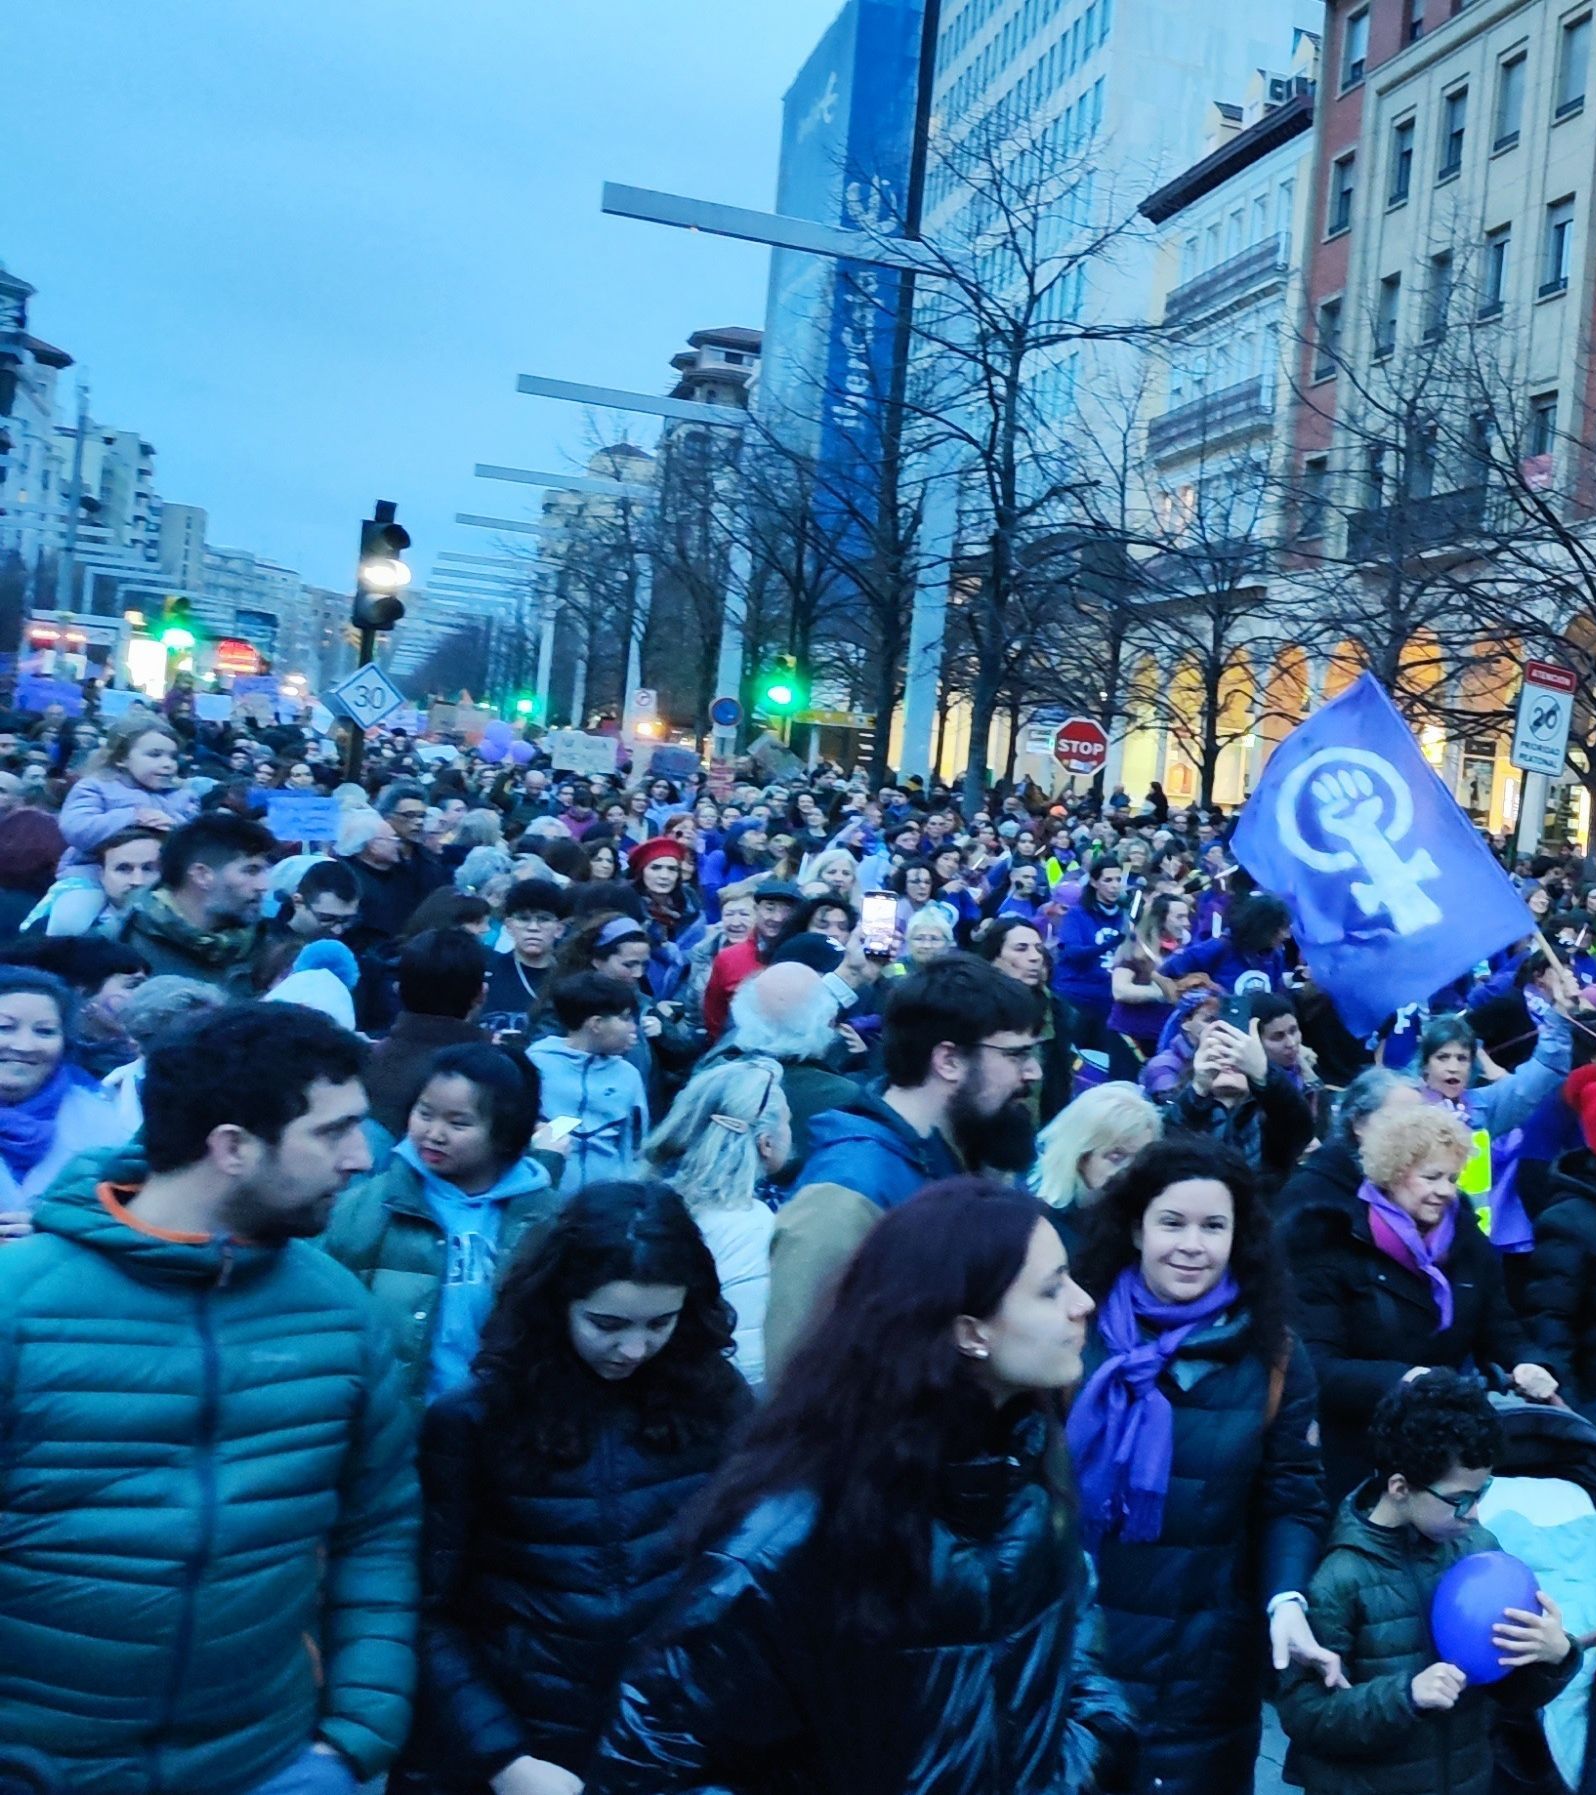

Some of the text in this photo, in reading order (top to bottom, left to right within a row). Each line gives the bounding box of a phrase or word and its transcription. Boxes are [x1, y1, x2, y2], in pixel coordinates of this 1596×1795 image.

[354, 685, 386, 709] 30
[1533, 706, 1558, 730] 20
[1057, 738, 1104, 756] STOP
